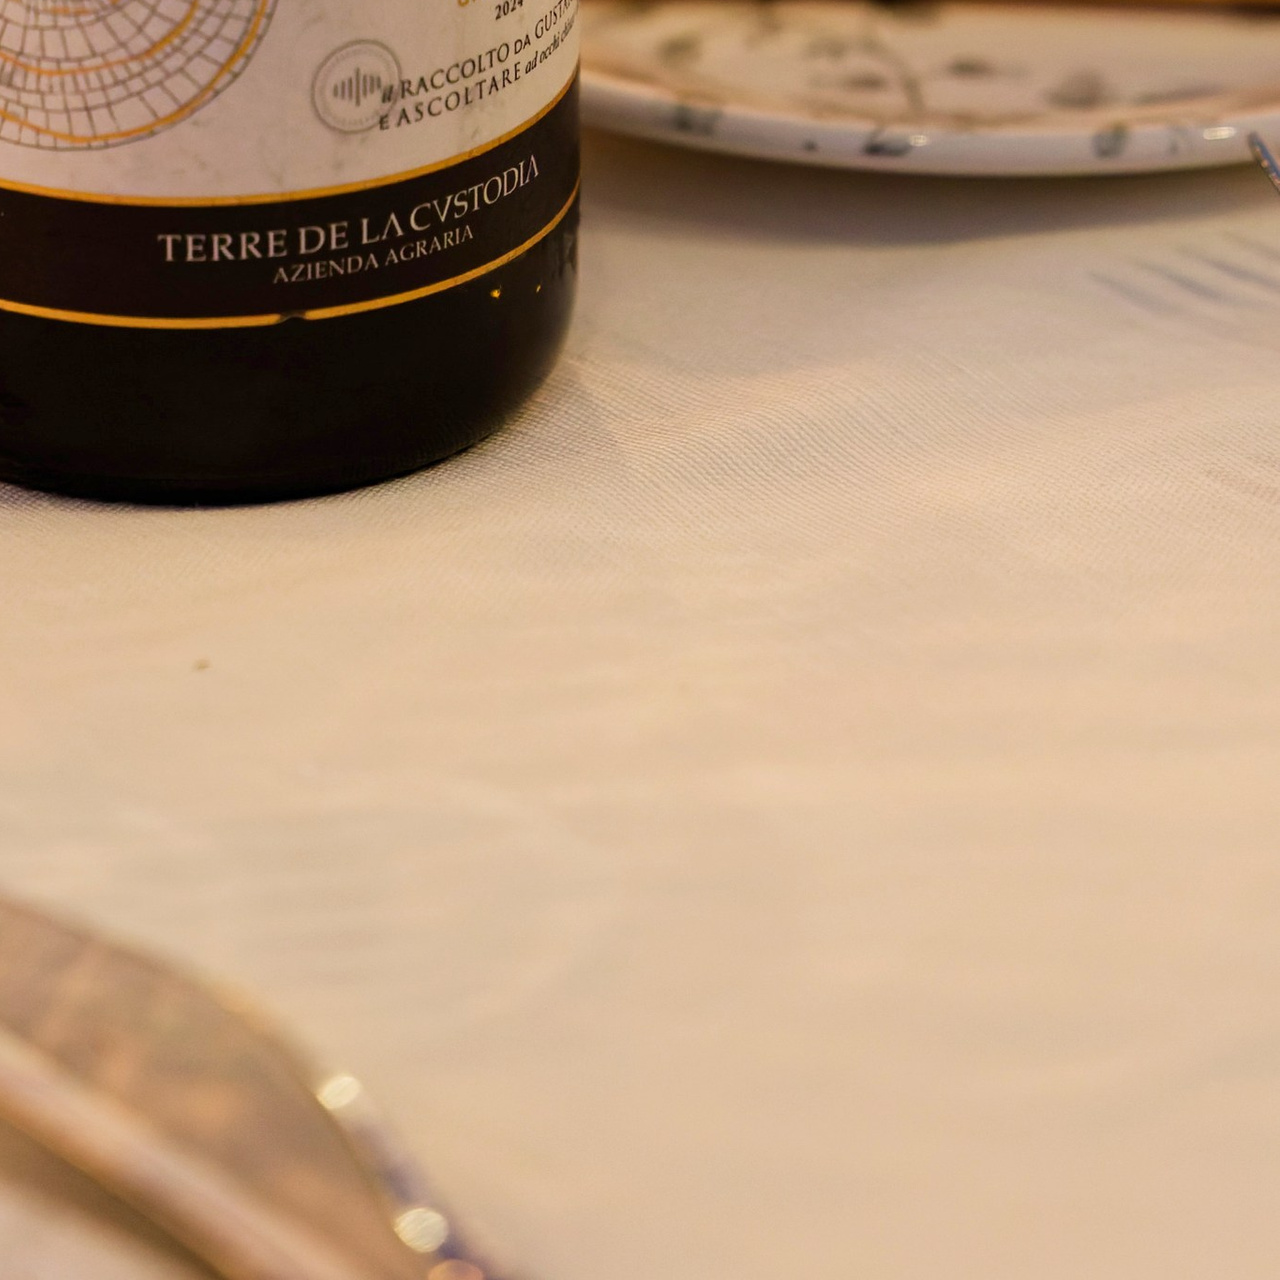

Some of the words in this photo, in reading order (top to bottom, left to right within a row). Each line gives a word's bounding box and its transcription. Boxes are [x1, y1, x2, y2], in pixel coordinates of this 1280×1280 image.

[379, 114, 390, 131] E
[396, 62, 521, 130] ASCOLTARE
[524, 50, 538, 73] ad
[400, 42, 509, 99] RACCOLTO
[514, 34, 531, 56] DA
[157, 228, 288, 263] TERRE
[298, 220, 349, 255] DE
[361, 211, 404, 245] LA
[273, 253, 380, 285] AZIENDA
[385, 224, 474, 266] AGRARIA
